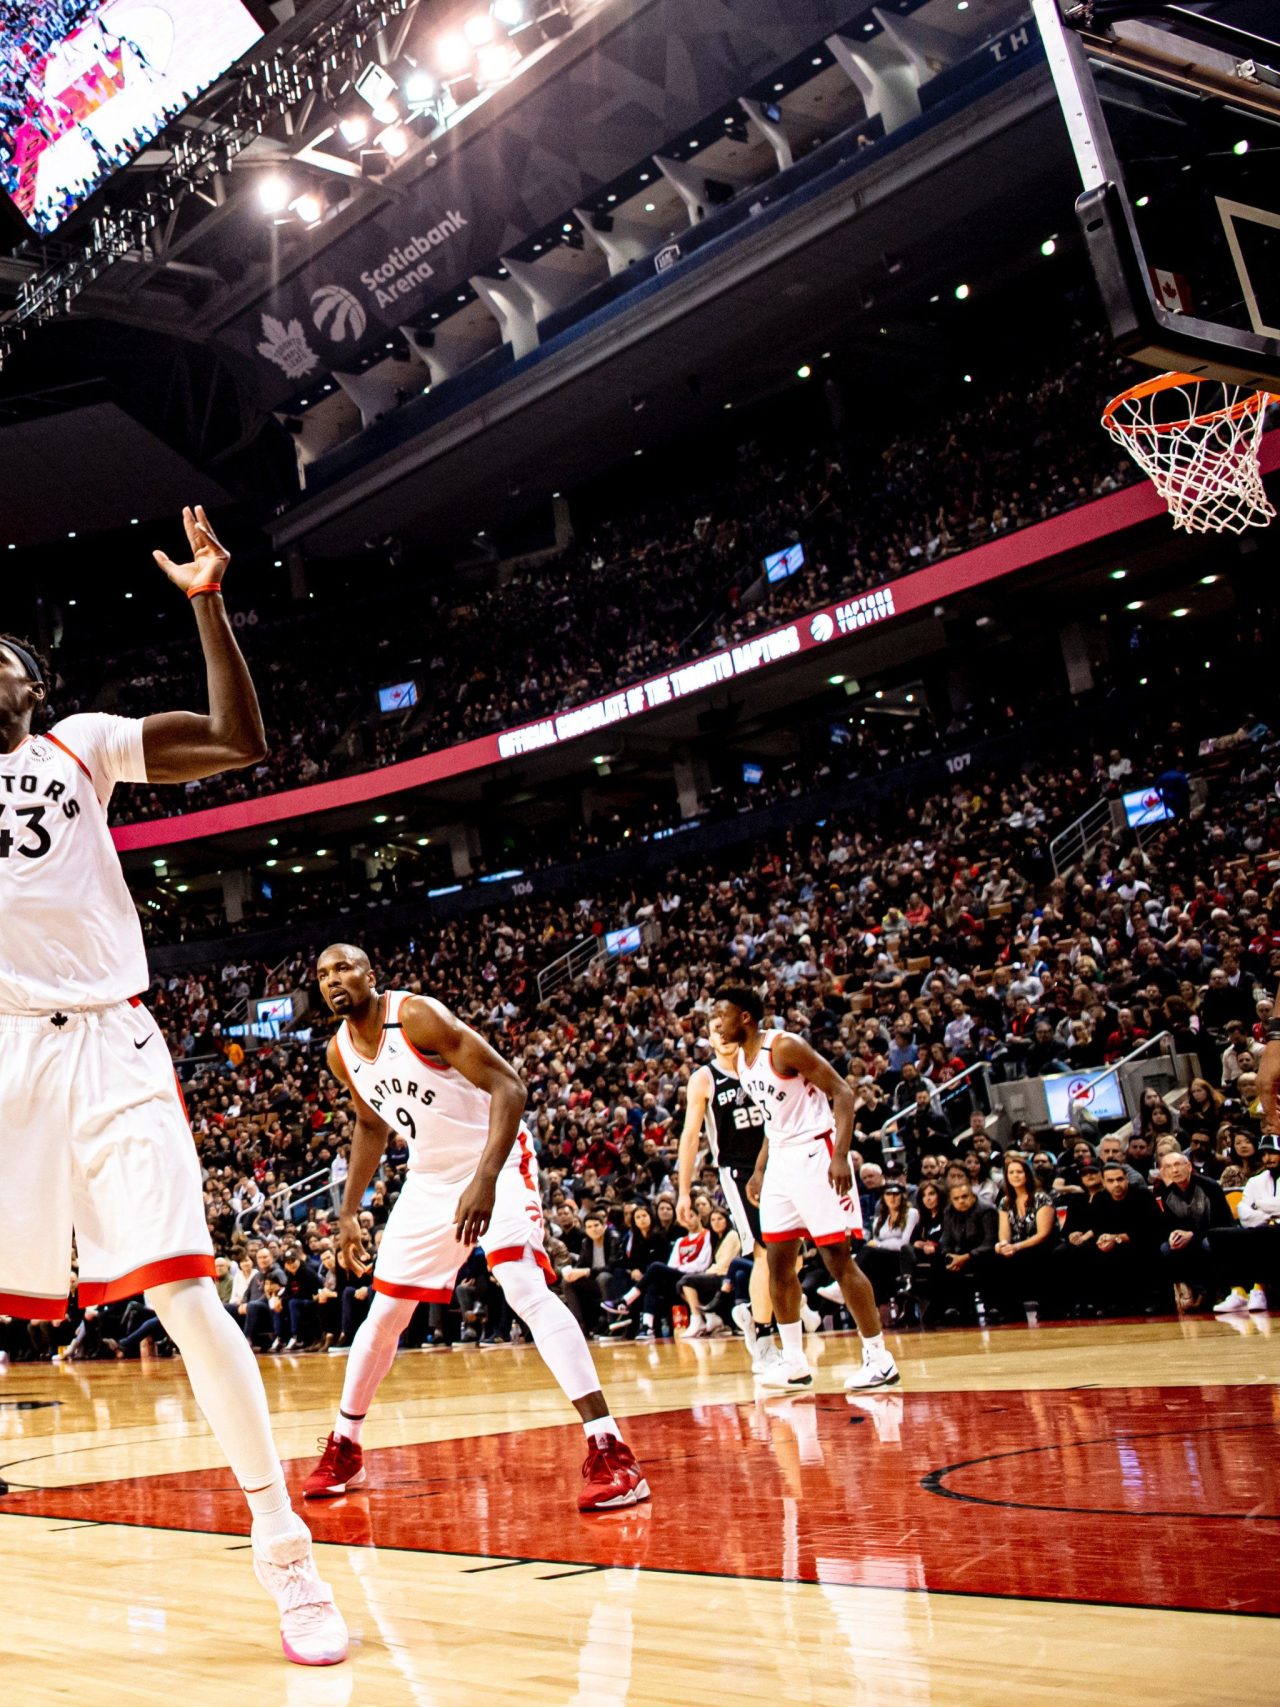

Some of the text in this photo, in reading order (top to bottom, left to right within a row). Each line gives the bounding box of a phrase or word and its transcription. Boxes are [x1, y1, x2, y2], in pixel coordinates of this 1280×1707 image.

[360, 209, 468, 291] Scotiabank
[374, 261, 434, 309] Arena
[731, 626, 800, 674] RAPTORS
[945, 752, 971, 774] 107
[511, 880, 534, 896] 106
[370, 1078, 436, 1112] APTORS
[396, 1107, 416, 1139] 9
[733, 1106, 764, 1130] 25
